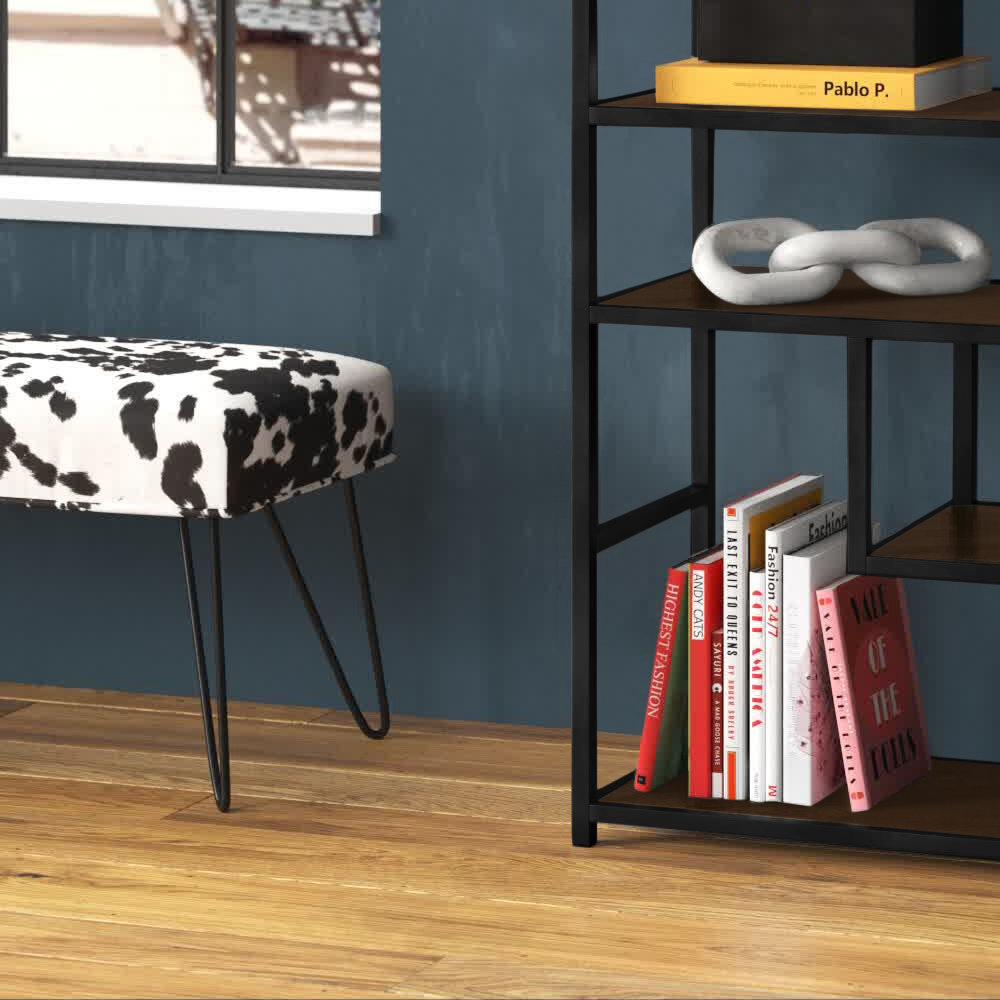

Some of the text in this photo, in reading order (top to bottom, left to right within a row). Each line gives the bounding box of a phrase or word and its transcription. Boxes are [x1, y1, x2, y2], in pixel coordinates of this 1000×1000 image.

[824, 81, 869, 97] Pablo
[875, 83, 888, 98] P.
[727, 530, 738, 561] LAST
[727, 564, 738, 589] EXIT
[767, 545, 780, 638] Fashion 24/7
[693, 573, 704, 638] ANDY CATS
[727, 596, 738, 608] TO
[646, 583, 680, 719] HIGHEST FASHION
[727, 614, 738, 656] QUEENS
[713, 642, 722, 677] SAYURI
